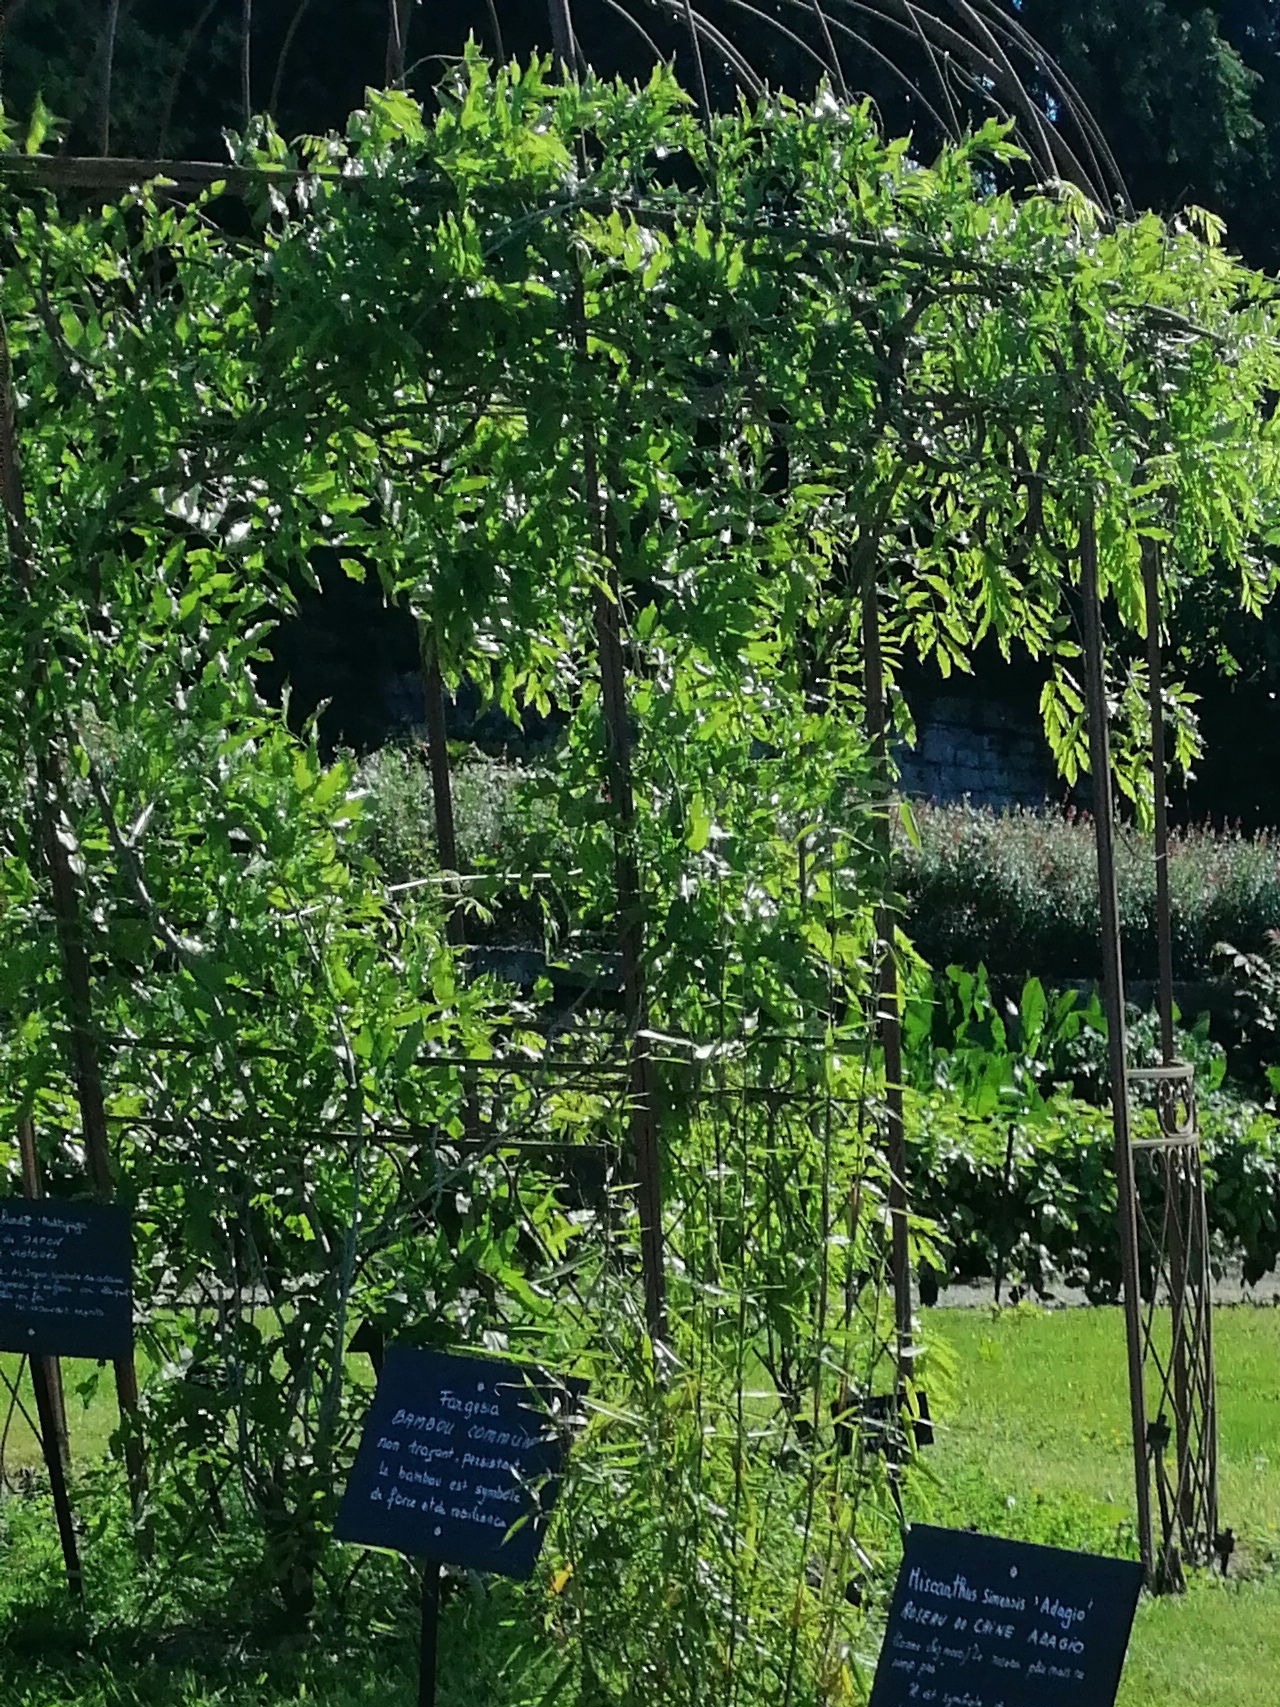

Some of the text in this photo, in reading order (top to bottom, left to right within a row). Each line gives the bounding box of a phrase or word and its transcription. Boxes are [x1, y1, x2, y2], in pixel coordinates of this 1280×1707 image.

[391, 1409, 454, 1435] BAMBOU
[377, 1436, 400, 1452] non
[399, 1465, 442, 1488] bambou
[449, 1477, 468, 1492] est
[908, 1567, 977, 1602] Miscanthus
[1028, 1628, 1084, 1655] ADAGIO
